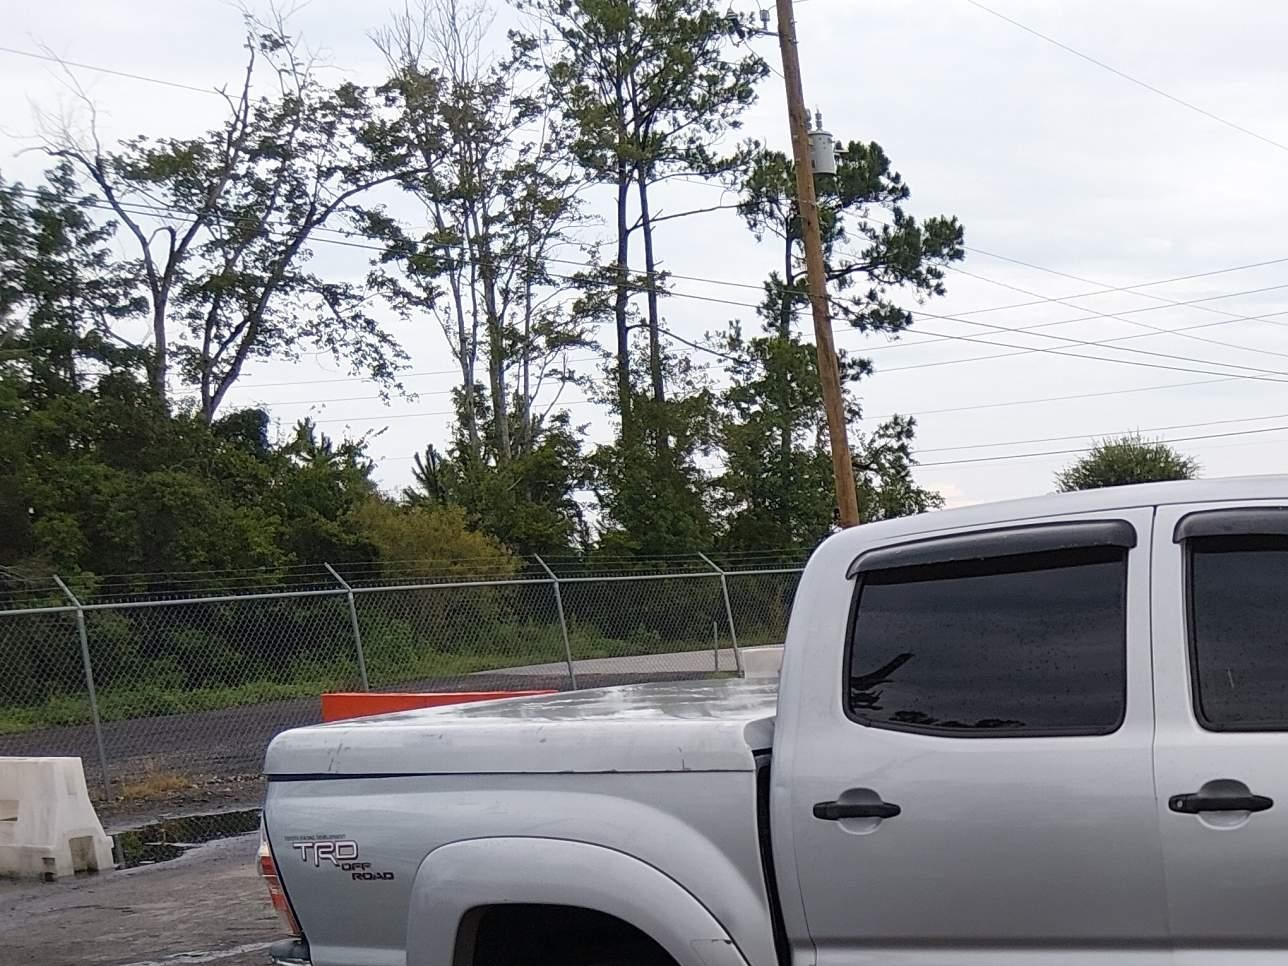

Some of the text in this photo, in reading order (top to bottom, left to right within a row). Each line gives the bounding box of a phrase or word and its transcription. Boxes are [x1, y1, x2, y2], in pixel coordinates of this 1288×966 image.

[292, 840, 358, 867] TRD
[341, 862, 371, 871] OFF
[352, 872, 394, 881] ROAD
